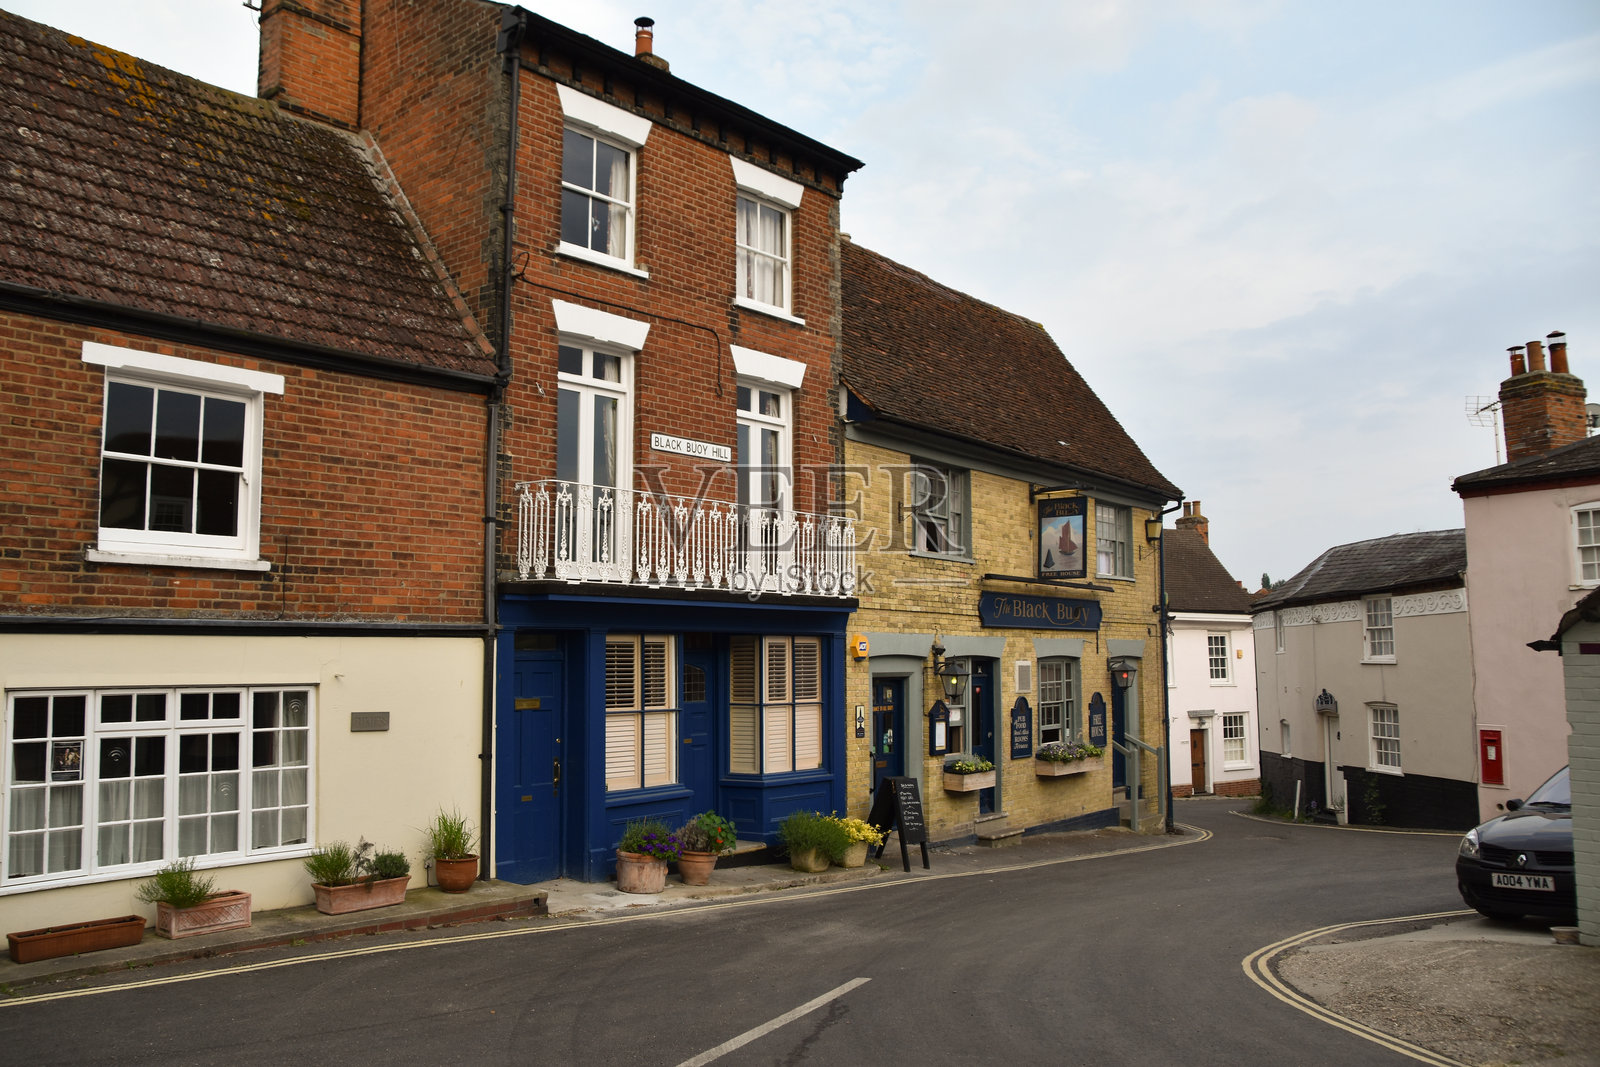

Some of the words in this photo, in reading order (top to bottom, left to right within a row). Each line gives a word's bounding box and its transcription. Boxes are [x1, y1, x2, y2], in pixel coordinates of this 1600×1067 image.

[654, 436, 682, 451] BLACK
[686, 442, 708, 455] BUOY
[712, 446, 729, 460] HILL
[993, 597, 1011, 618] The
[1013, 599, 1049, 619] Black
[1057, 602, 1090, 626] Buoy
[1017, 715, 1026, 723] PUB
[1092, 714, 1102, 725] FREE
[1091, 726, 1104, 738] HOUSE
[1525, 876, 1549, 889] YWA
